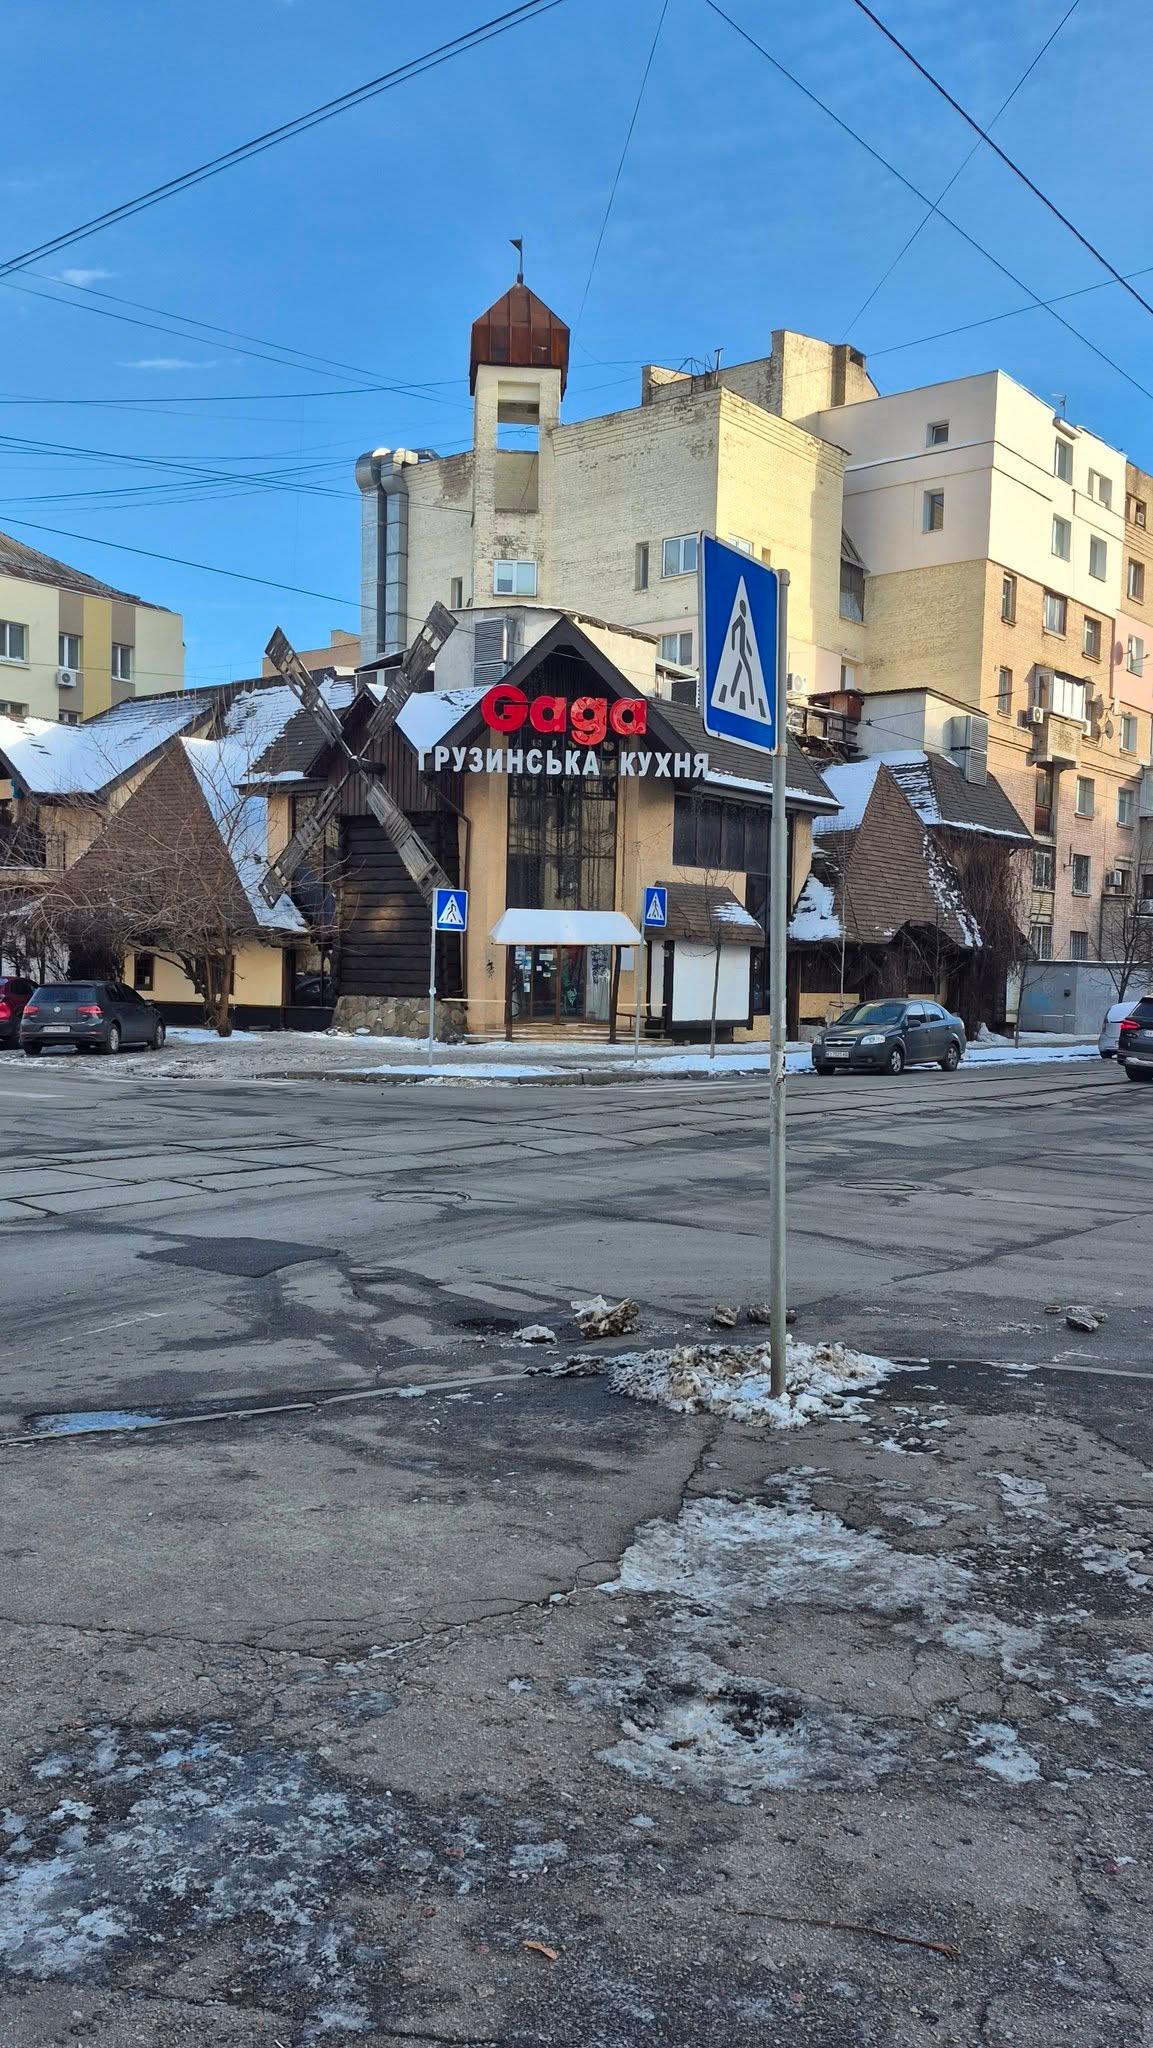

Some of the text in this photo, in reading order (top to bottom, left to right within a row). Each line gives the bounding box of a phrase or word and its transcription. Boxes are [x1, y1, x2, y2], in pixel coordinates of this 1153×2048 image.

[480, 683, 648, 746] Gaga
[417, 746, 710, 778] ГРУЗИНСЬКА КУХНЯ
